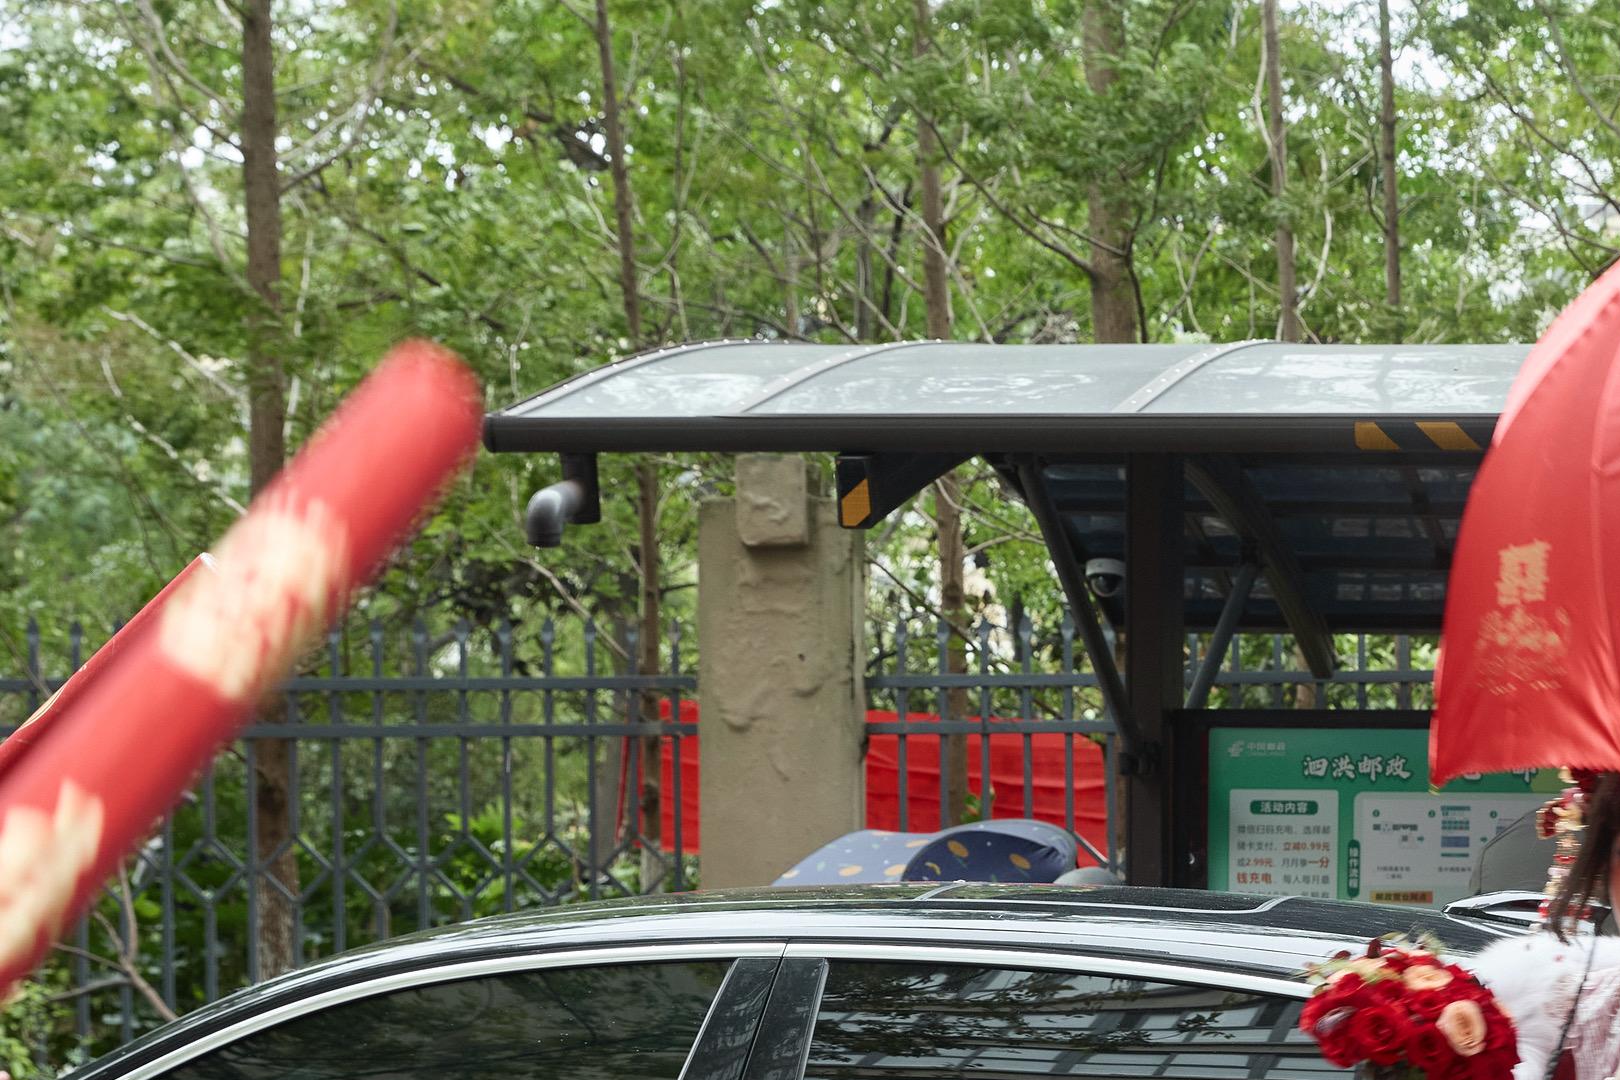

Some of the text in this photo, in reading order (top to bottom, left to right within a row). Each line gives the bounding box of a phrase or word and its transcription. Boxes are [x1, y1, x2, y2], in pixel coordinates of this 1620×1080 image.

[1303, 755, 1412, 782] 泗洪邮政
[1260, 802, 1308, 814] 活动内容
